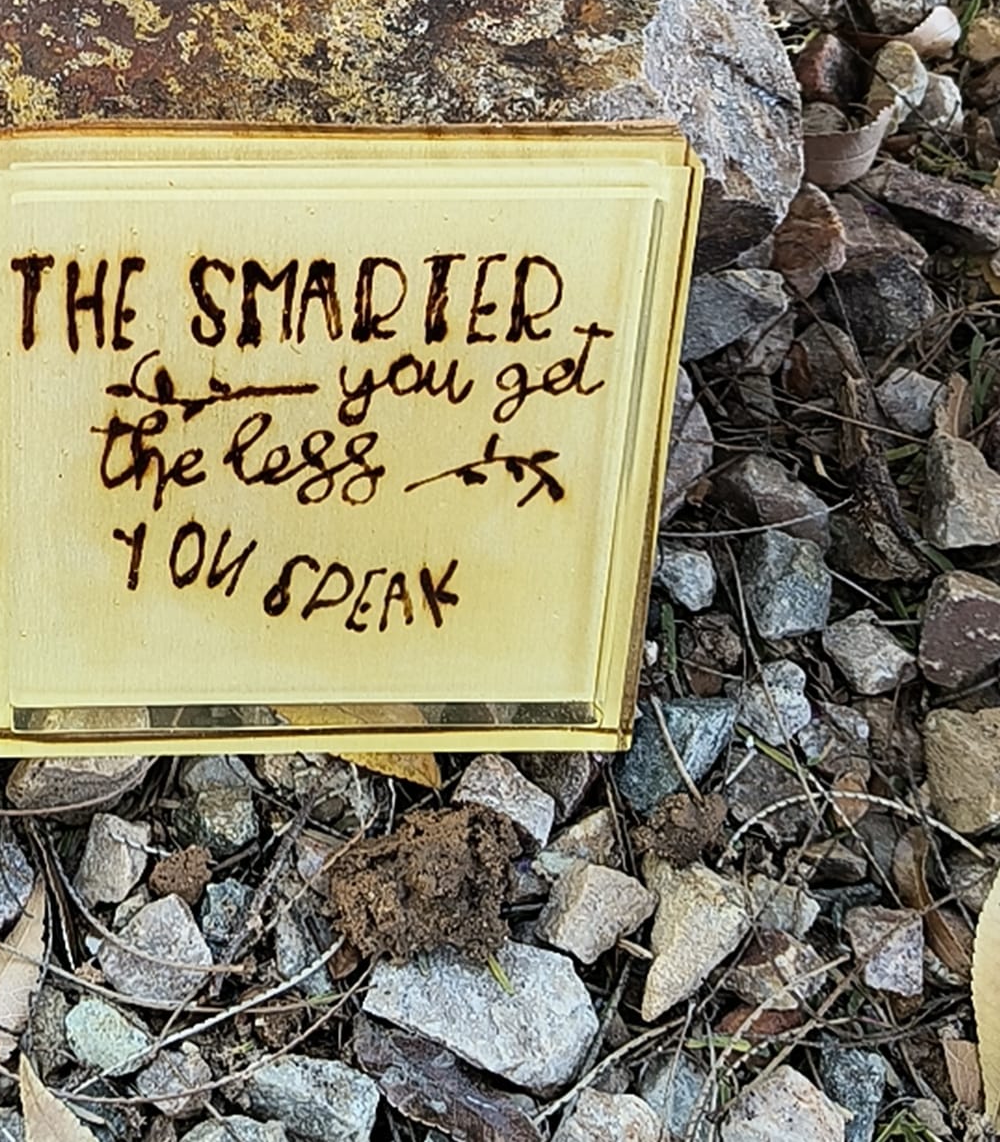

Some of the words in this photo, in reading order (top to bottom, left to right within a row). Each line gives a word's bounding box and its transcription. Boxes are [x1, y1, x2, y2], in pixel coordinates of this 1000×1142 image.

[10, 254, 147, 353] THE
[190, 252, 565, 348] SMARTER
[337, 353, 475, 426] you
[492, 321, 615, 423] get
[90, 404, 206, 511] the
[221, 411, 386, 505] less
